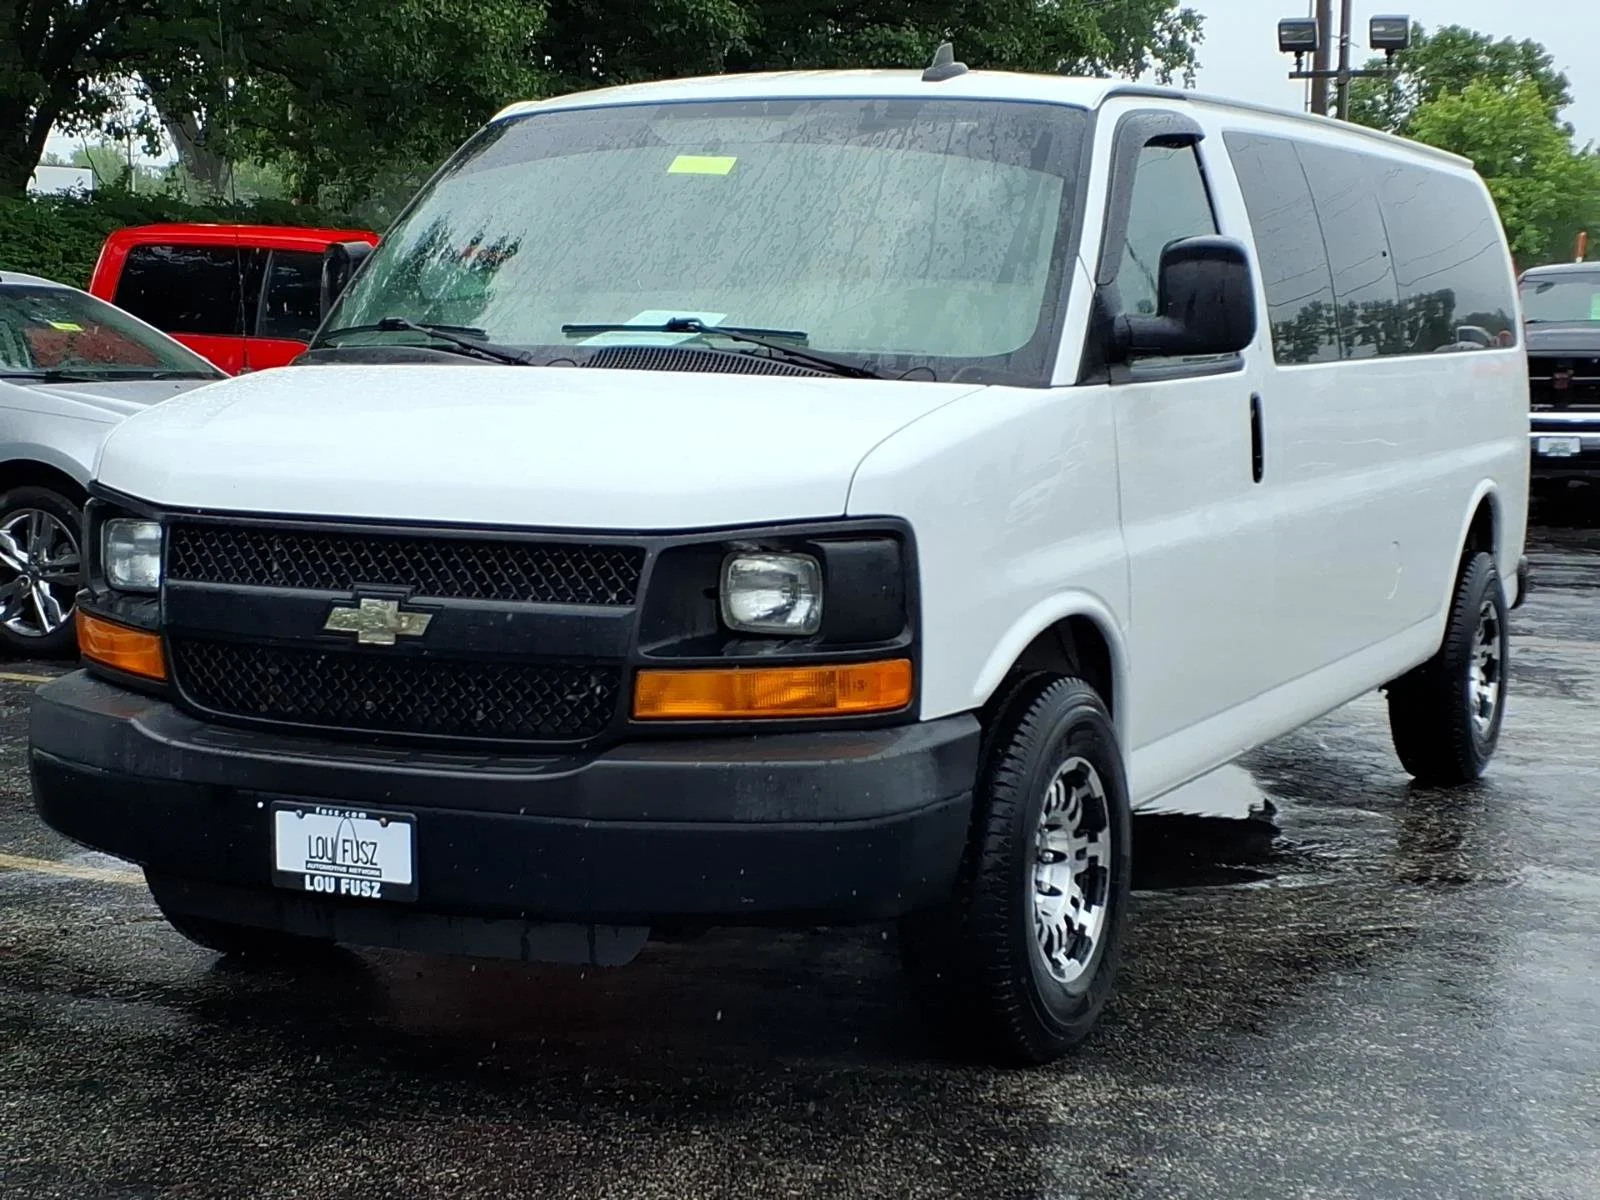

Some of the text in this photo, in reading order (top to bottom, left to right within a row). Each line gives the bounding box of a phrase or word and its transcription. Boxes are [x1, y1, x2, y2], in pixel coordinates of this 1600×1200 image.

[308, 835, 378, 866] LOU FUSZ
[304, 874, 382, 899] LOU FUSZ
